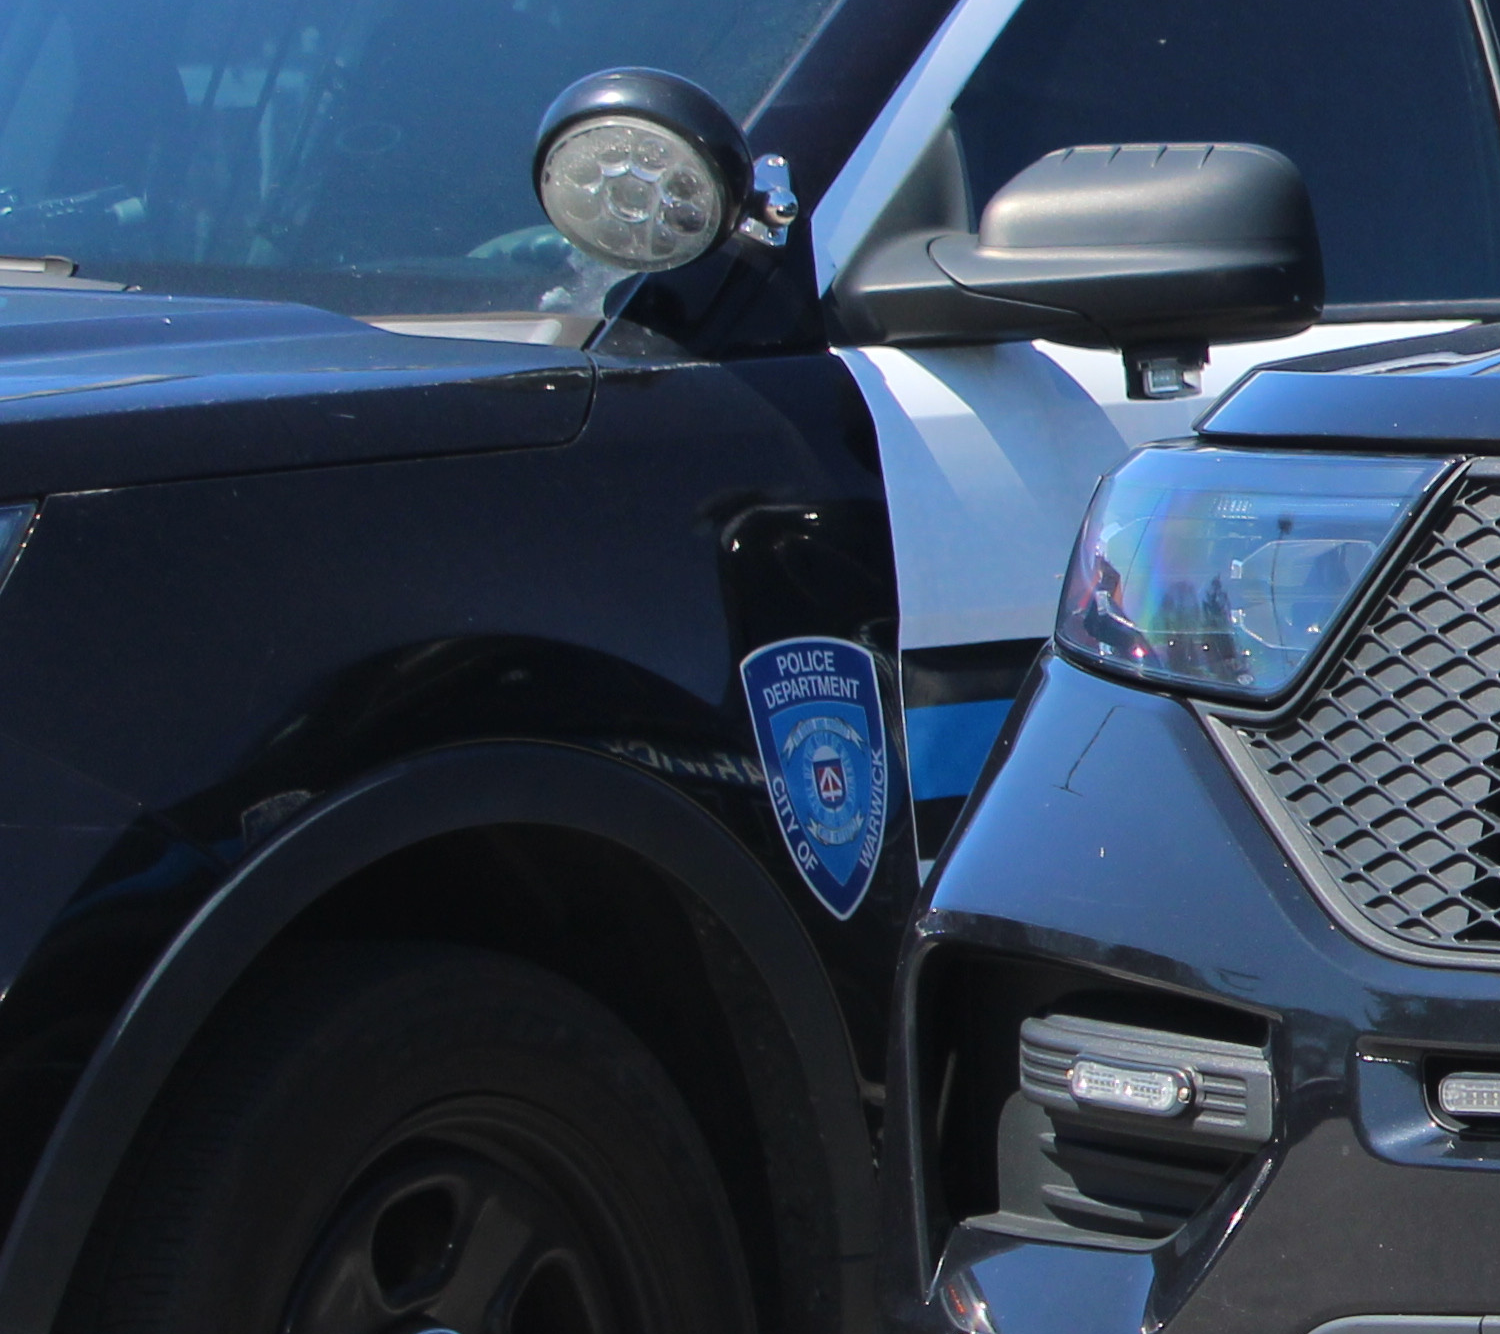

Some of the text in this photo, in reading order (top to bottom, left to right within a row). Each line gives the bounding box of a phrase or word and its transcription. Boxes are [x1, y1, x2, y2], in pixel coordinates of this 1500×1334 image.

[763, 675, 860, 709] DEPARTMENT
[776, 650, 835, 676] POLICE
[772, 775, 819, 872] CITY OF
[860, 747, 884, 869] WARWICK
